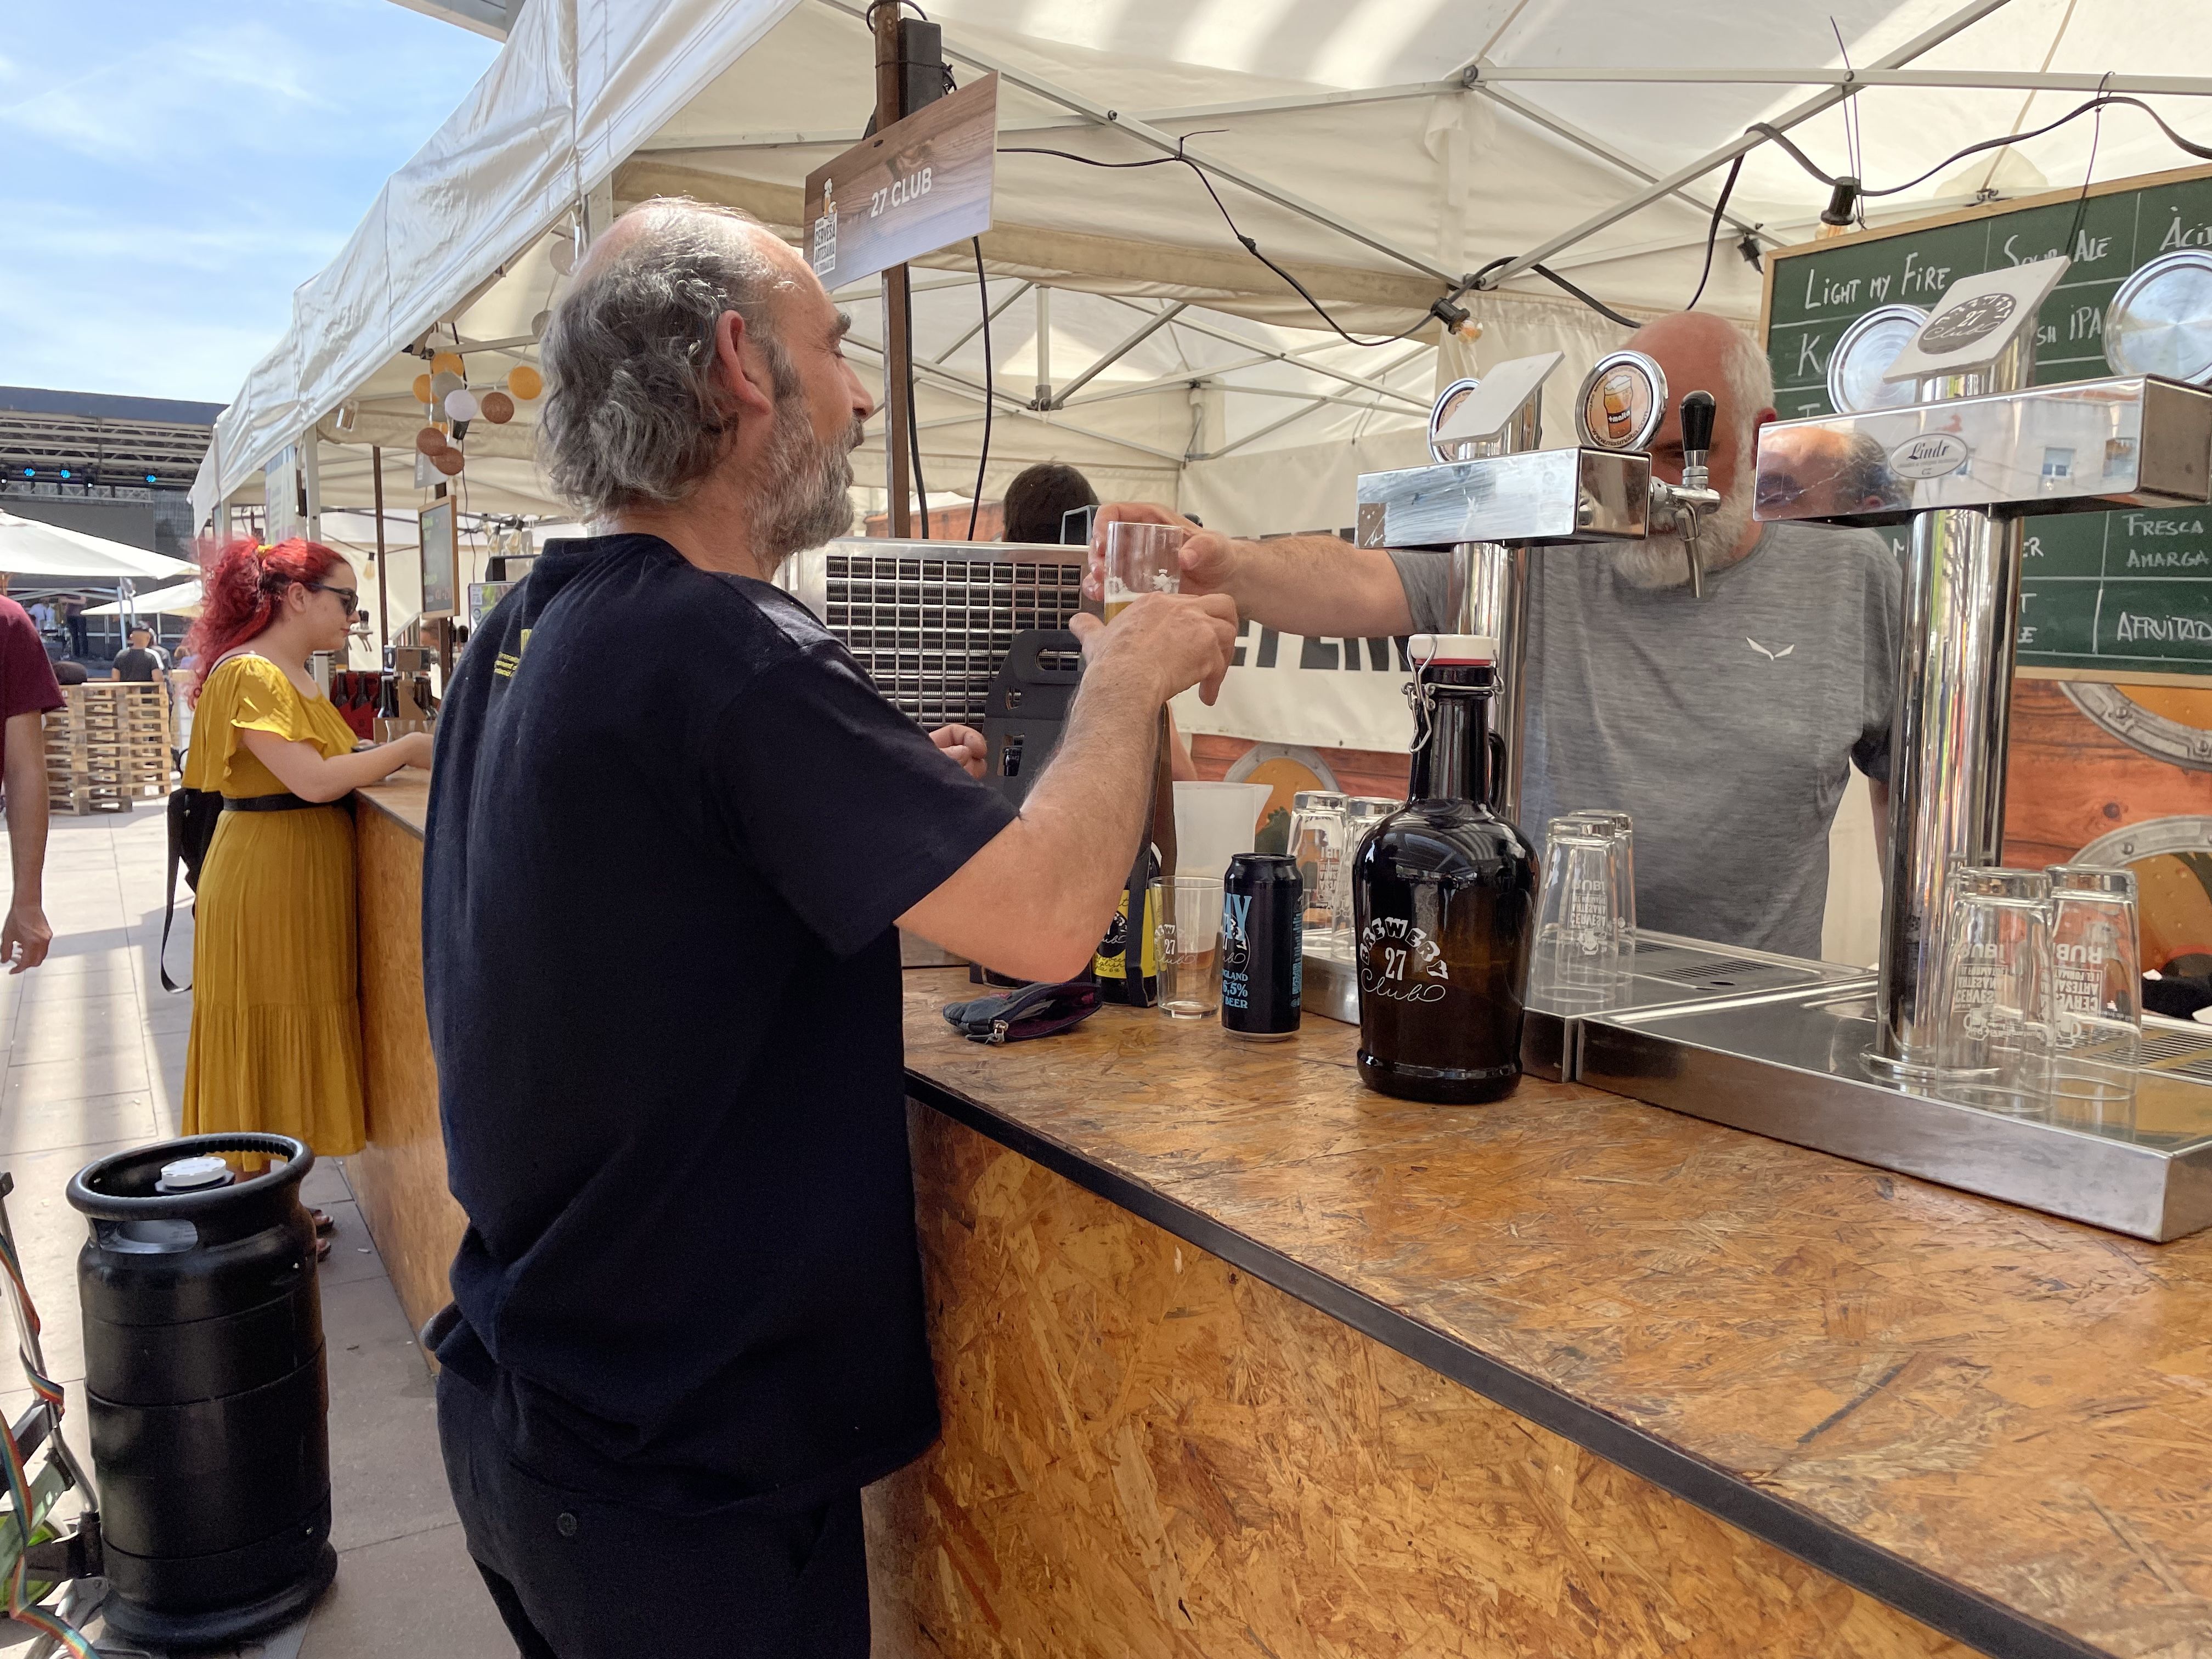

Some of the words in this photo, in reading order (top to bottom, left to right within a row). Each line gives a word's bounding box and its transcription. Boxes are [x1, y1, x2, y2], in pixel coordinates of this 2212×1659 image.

[871, 187, 888, 218] 27
[891, 167, 932, 207] CLUB
[1957, 309, 1987, 328] 27
[1908, 439, 1950, 460] Lindr
[2121, 513, 2204, 537] FRESCA
[1165, 938, 1176, 955] 27
[1359, 917, 1449, 980] BREWERY
[1384, 947, 1407, 981] 27
[1222, 979, 1249, 998] 6,5%
[1361, 968, 1446, 1002] Club
[1224, 997, 1249, 1009] BEER
